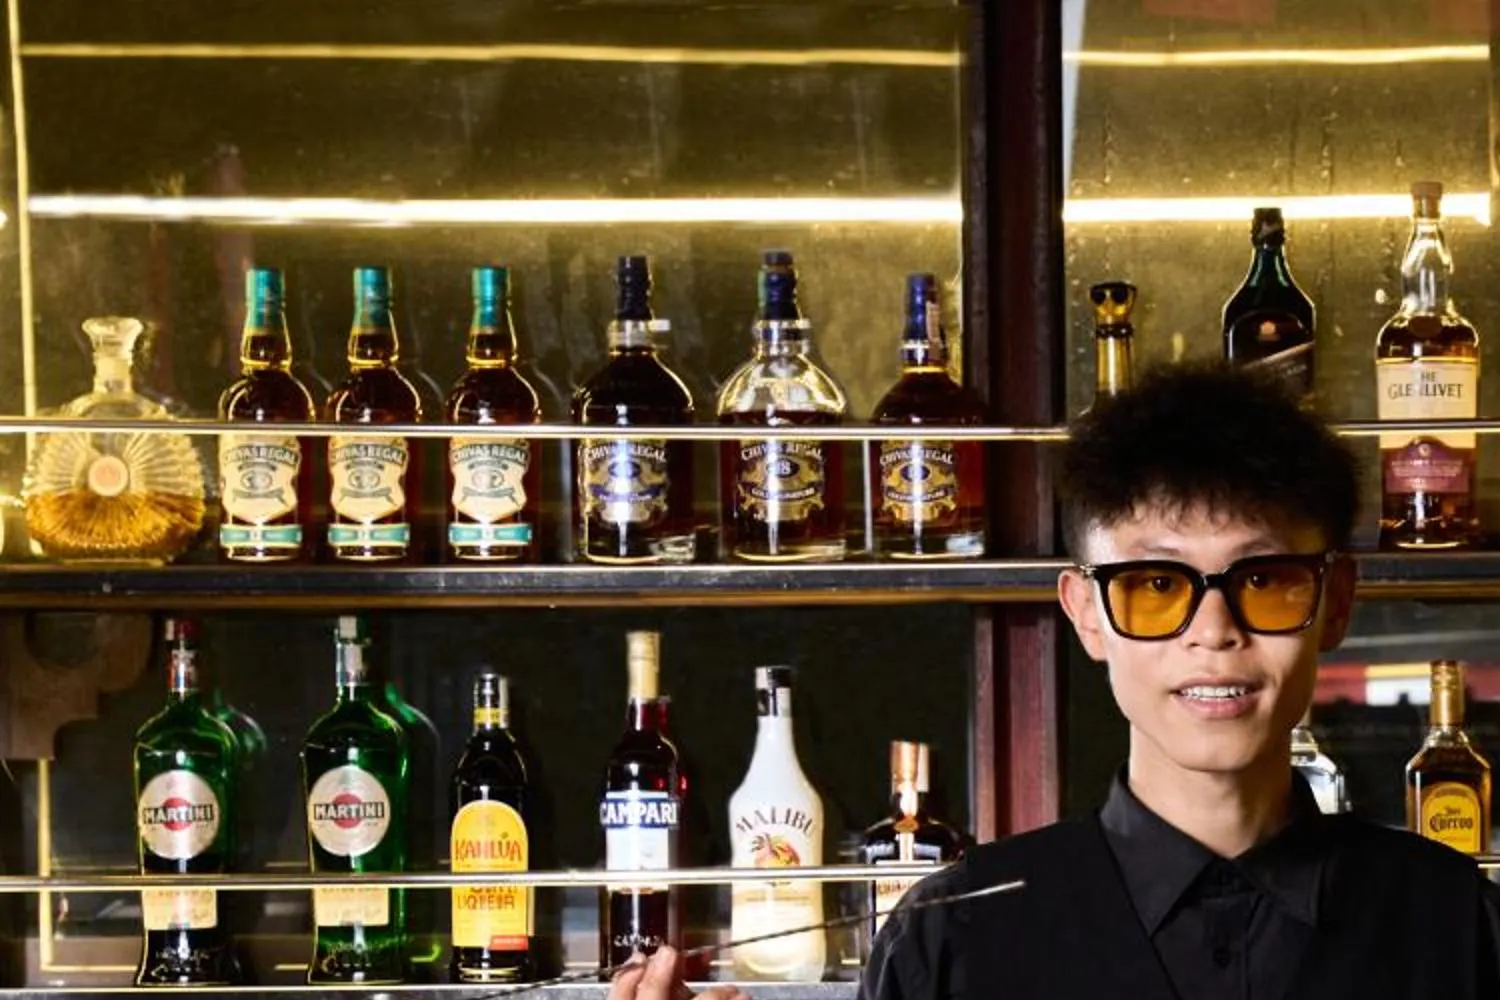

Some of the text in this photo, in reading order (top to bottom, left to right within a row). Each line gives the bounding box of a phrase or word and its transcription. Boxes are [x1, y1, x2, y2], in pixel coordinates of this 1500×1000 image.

[314, 803, 384, 820] MARTINI
[601, 801, 678, 825] CAMPARI
[736, 806, 817, 838] MALIBU
